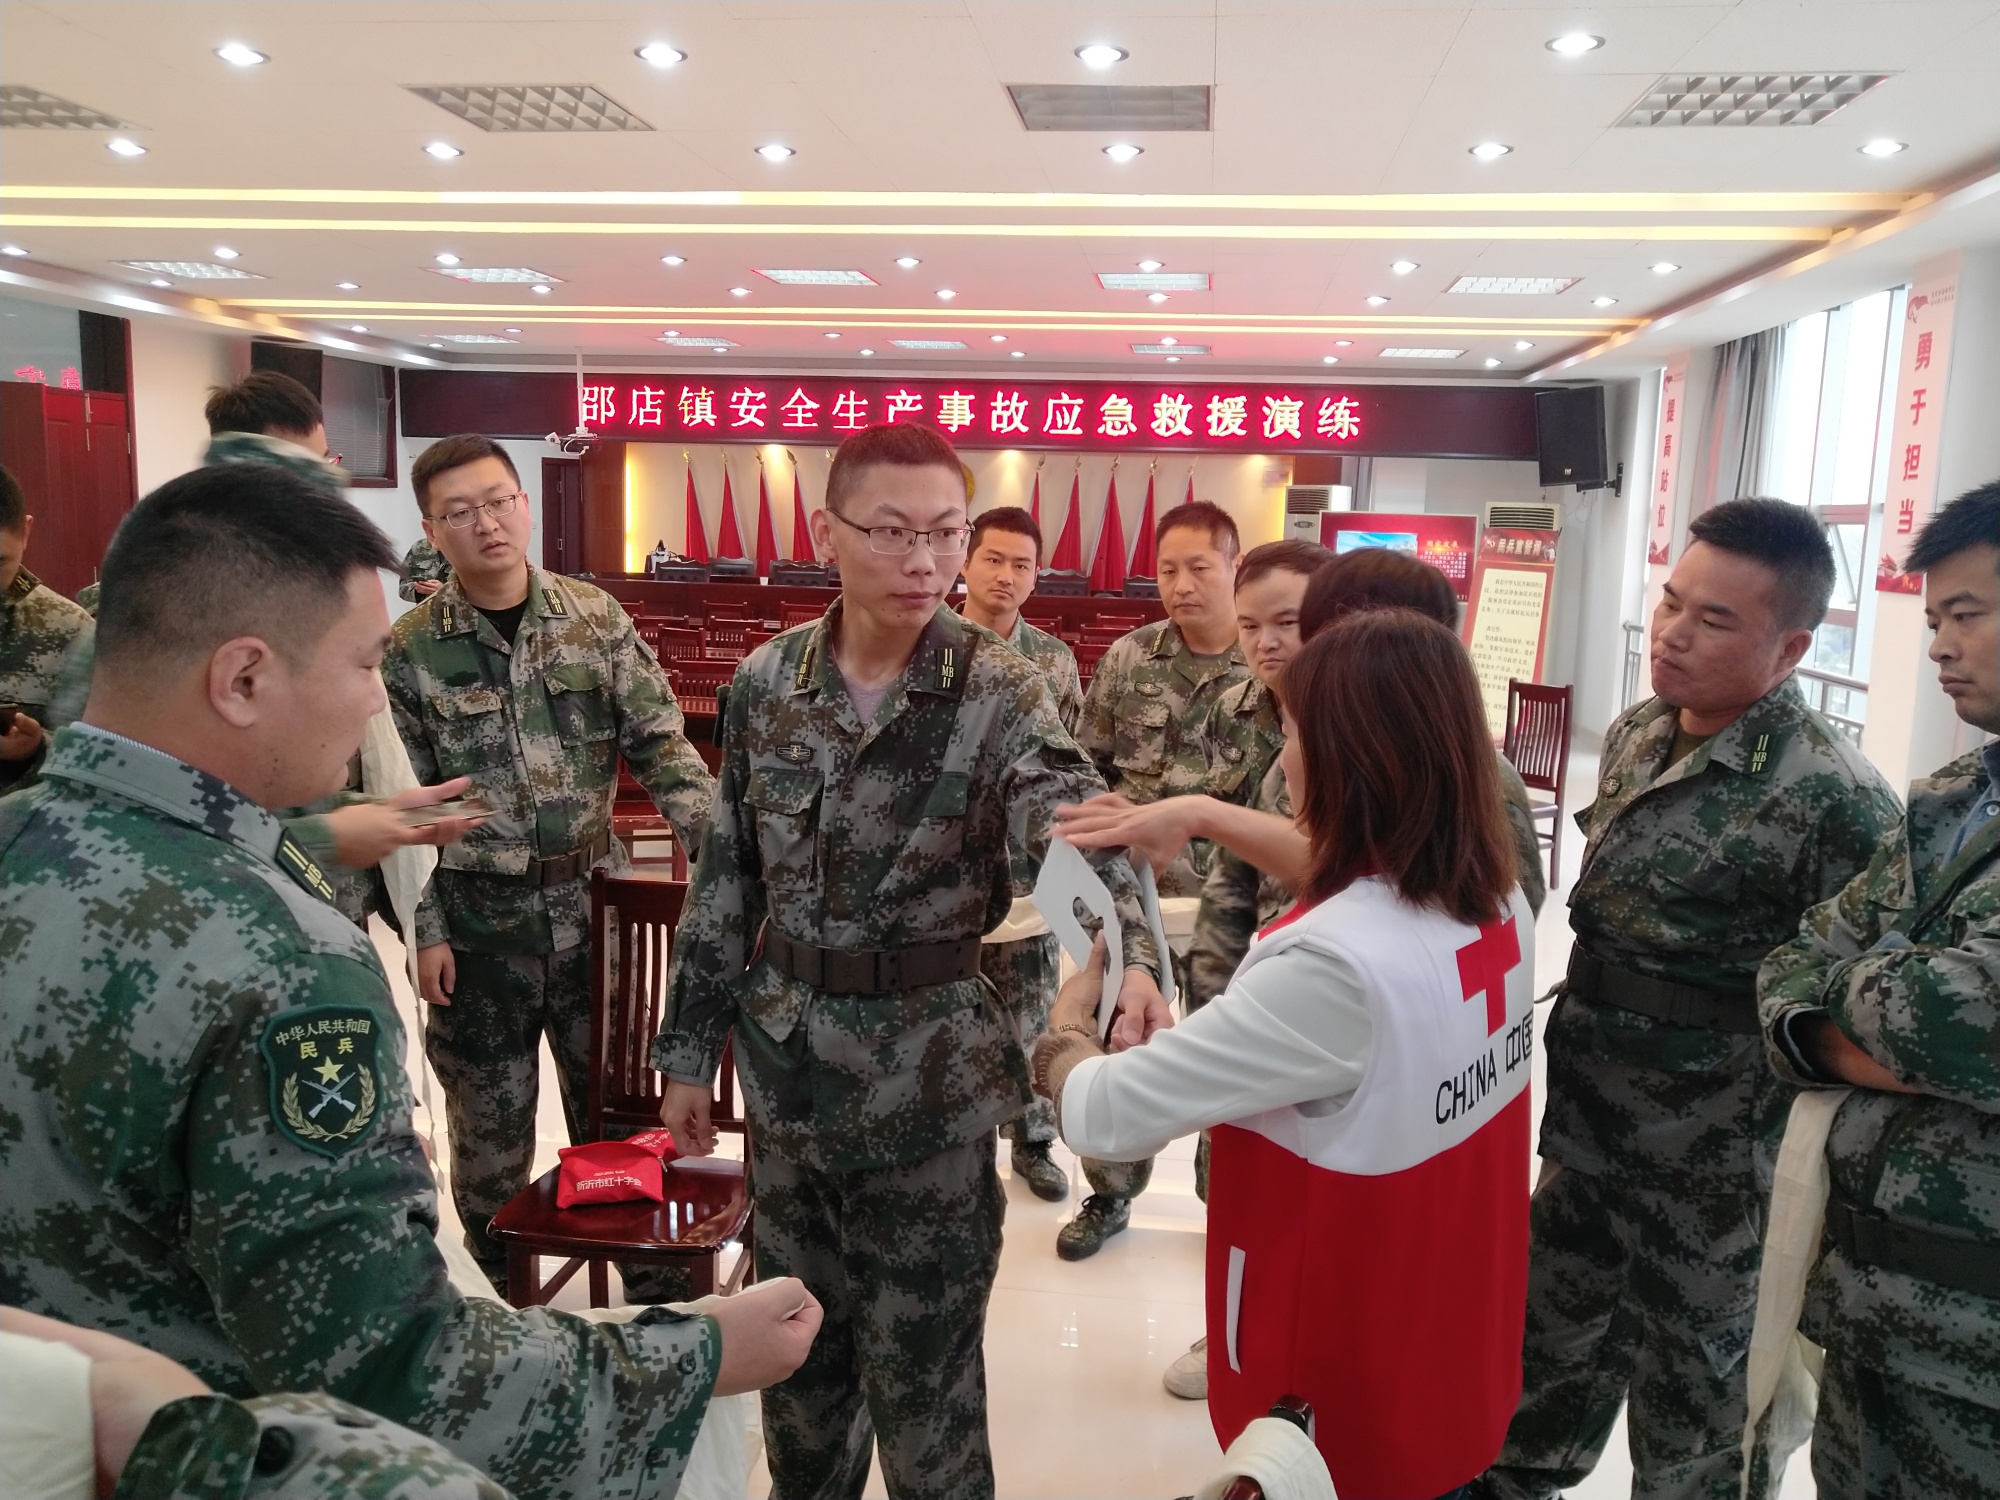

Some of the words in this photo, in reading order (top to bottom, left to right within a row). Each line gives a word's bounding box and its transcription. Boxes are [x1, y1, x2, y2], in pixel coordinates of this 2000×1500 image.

[582, 385, 1361, 440] 邵店镇安全生产事故应急救援演练
[1897, 331, 1933, 535] 勇于担当
[941, 664, 954, 678] MB
[1752, 751, 1767, 763] MB
[304, 863, 322, 888] MB
[275, 1018, 371, 1046] 中华人民共和国
[300, 1037, 354, 1060] 民兵
[1435, 1047, 1498, 1125] CHINA
[1505, 1007, 1534, 1074] 中国
[576, 1176, 642, 1192] 新沂市红十字会
